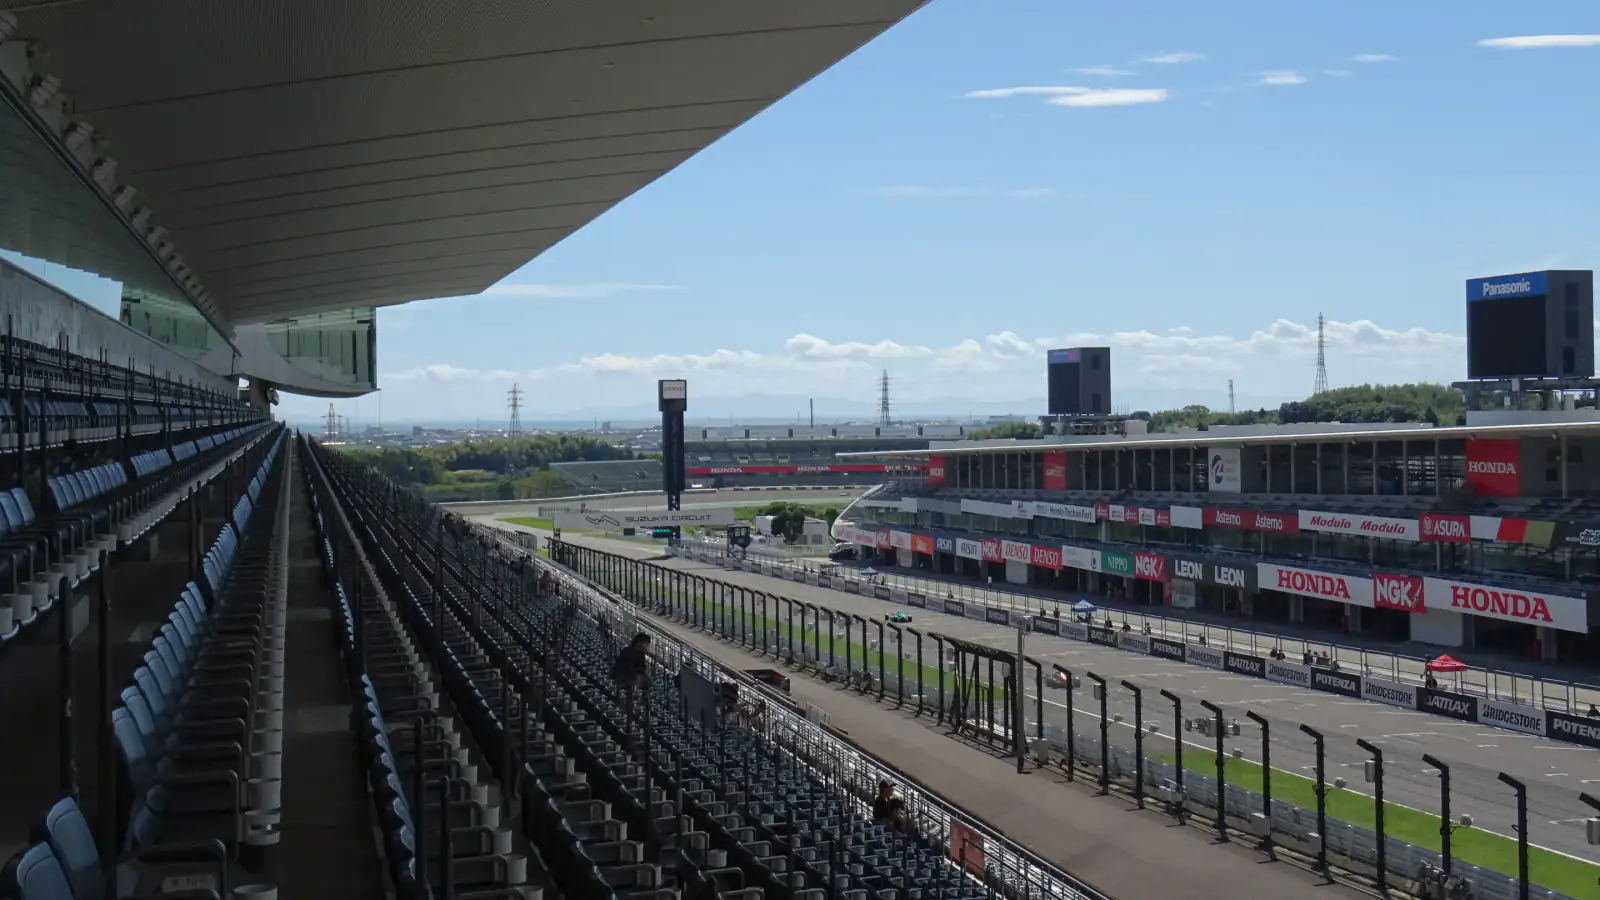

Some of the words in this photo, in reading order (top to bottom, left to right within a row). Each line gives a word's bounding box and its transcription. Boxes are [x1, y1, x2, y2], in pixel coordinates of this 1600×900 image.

[1483, 278, 1531, 296] Panasonic
[1468, 461, 1516, 475] HONDA
[1215, 509, 1241, 525] Astemo
[1255, 514, 1283, 530] Astemo
[1310, 515, 1351, 529] Modulo
[1360, 520, 1405, 534] Modulo
[1433, 519, 1465, 537] ASURA
[982, 541, 998, 559] NGK
[1005, 544, 1028, 560] DENSO
[1034, 549, 1058, 565] DENSO
[1107, 556, 1127, 571] NIPPO
[1135, 555, 1157, 576] NGK
[1174, 560, 1203, 580] LEON
[1214, 565, 1245, 588] LEON
[1277, 569, 1350, 598] HONDA
[1375, 577, 1412, 606] NGK
[1451, 585, 1553, 623] HONDA
[1153, 641, 1182, 657] POTENZA
[1269, 663, 1308, 683] BRIDGESTONE
[1315, 672, 1356, 692] POTENZA
[1365, 681, 1413, 705] BRIDGESTONE
[1482, 703, 1541, 731] BRIDGESTONE
